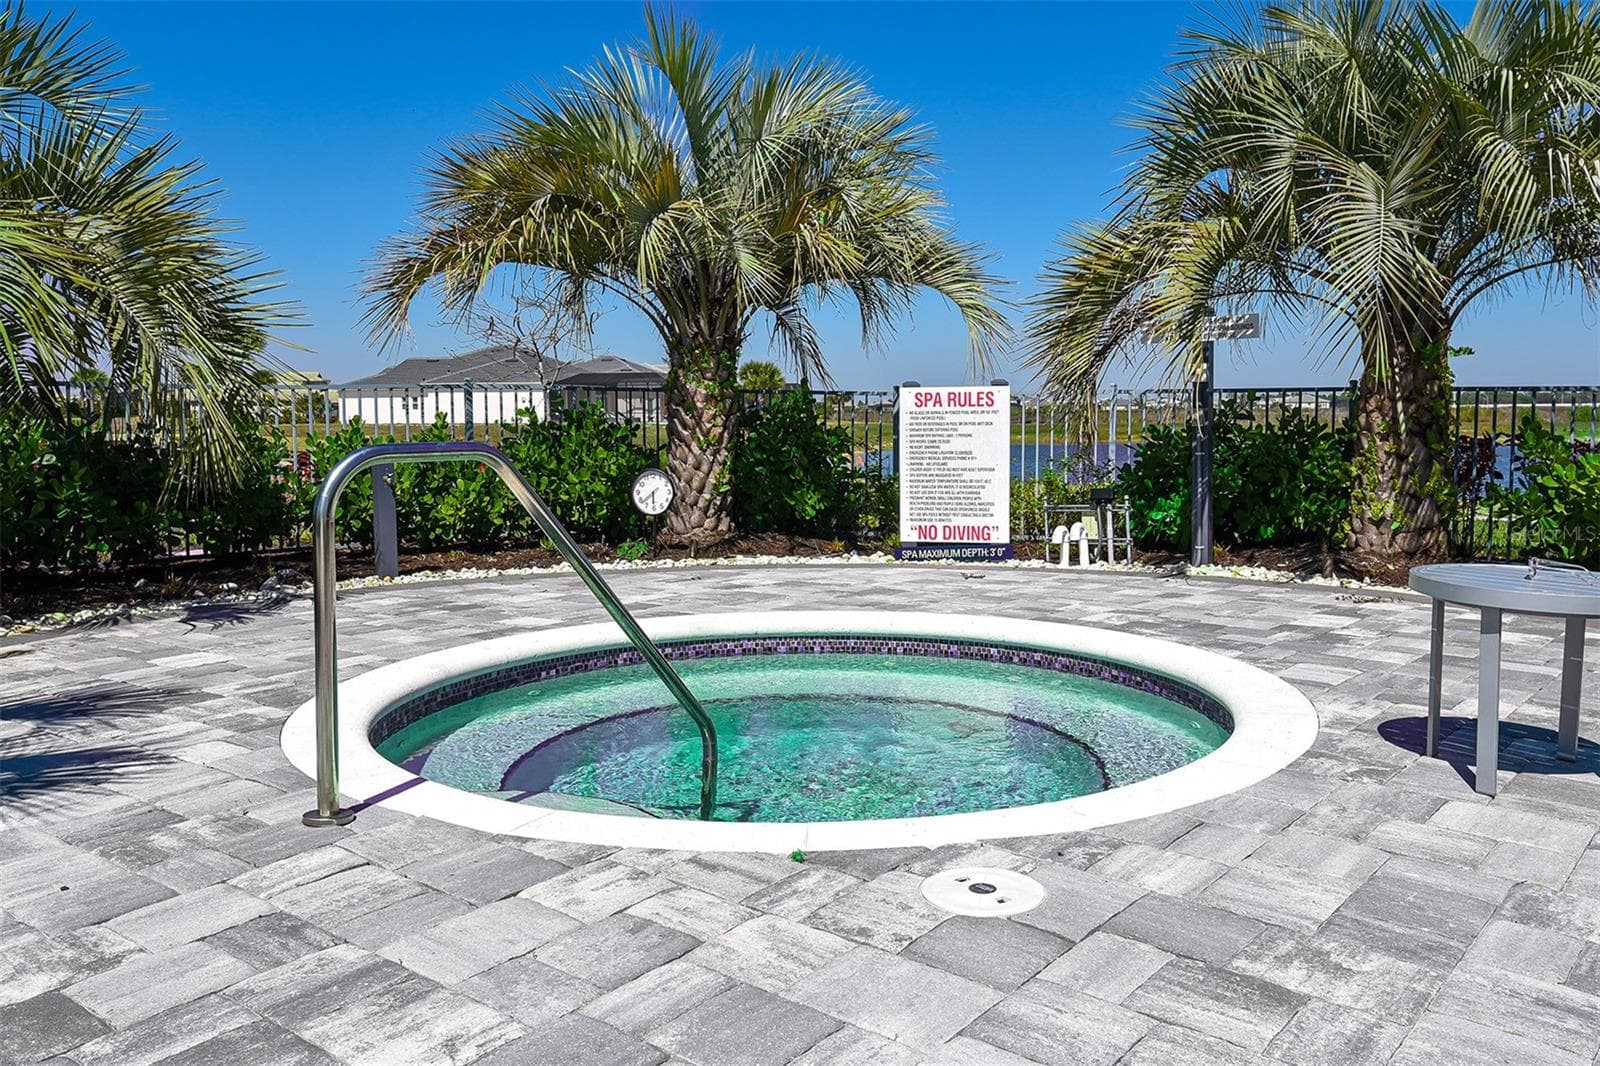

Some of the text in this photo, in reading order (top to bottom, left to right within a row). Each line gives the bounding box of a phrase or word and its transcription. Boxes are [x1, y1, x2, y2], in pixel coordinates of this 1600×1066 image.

[914, 392, 994, 408] SPA RULES
[902, 550, 918, 559] SPA
[919, 549, 960, 558] MAXIMUM
